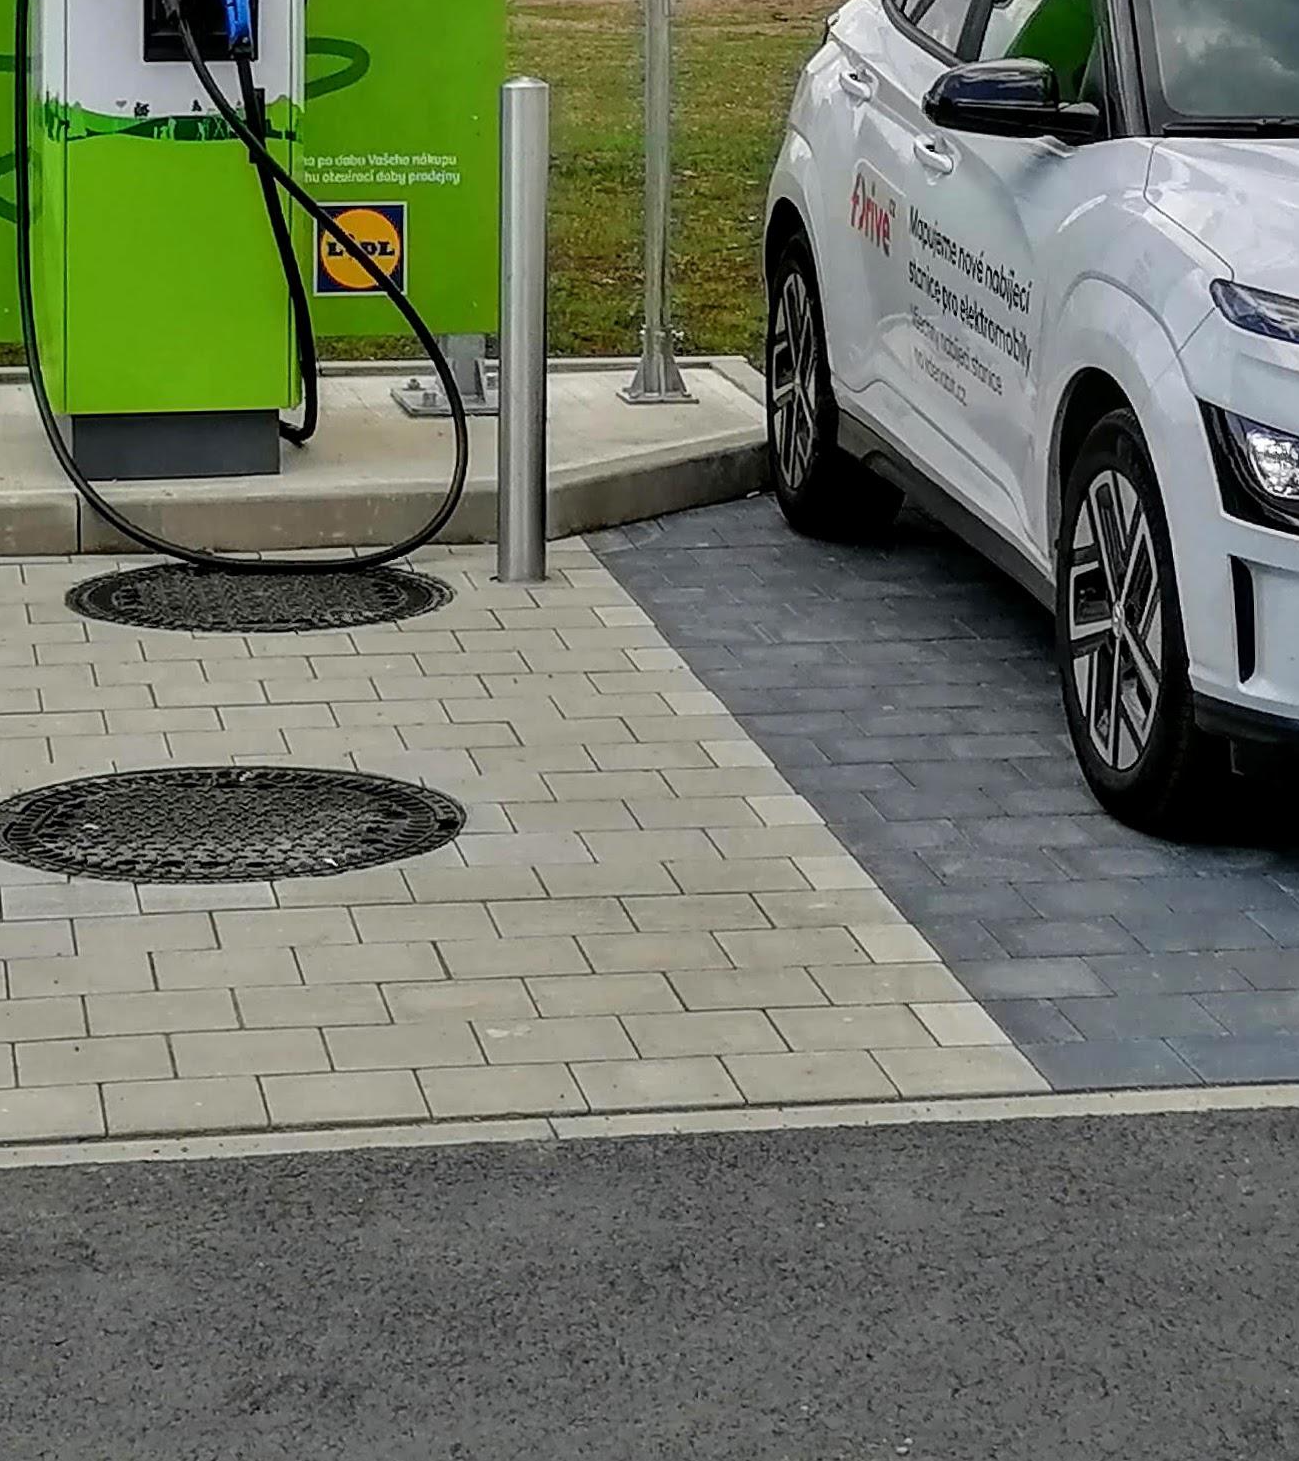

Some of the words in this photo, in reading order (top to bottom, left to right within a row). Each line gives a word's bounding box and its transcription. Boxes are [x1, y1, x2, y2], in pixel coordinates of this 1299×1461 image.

[368, 152, 410, 167] Vašeho
[412, 152, 457, 168] nákupu
[408, 170, 460, 186] prodejny
[957, 246, 984, 284] nové
[985, 263, 1033, 314] nabíjecí
